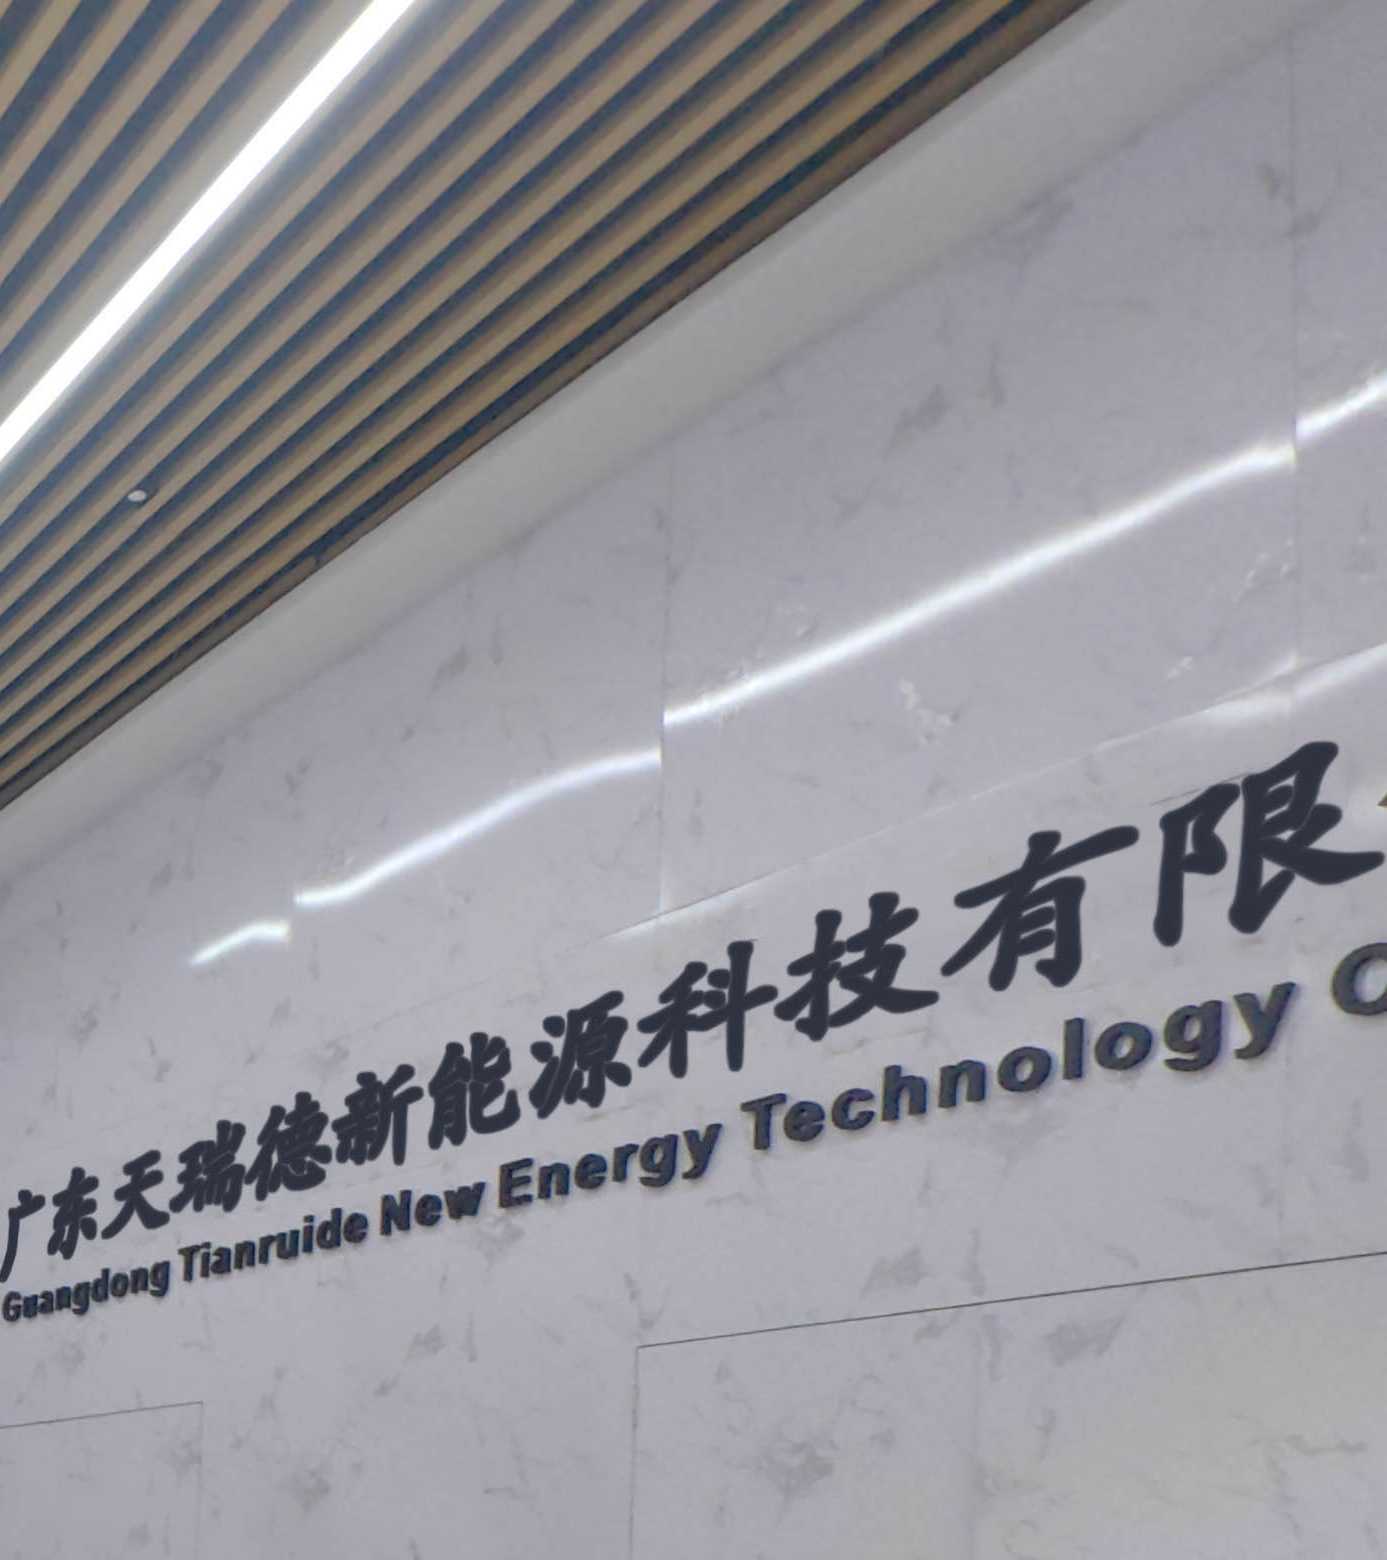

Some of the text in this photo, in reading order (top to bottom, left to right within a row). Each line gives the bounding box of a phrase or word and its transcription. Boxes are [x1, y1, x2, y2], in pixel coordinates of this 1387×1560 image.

[2, 1259, 171, 1322] Guangdong
[178, 1207, 369, 1282] Tianruide
[380, 1180, 486, 1236] New
[499, 1122, 723, 1209] Energy
[741, 981, 1297, 1151] Technology
